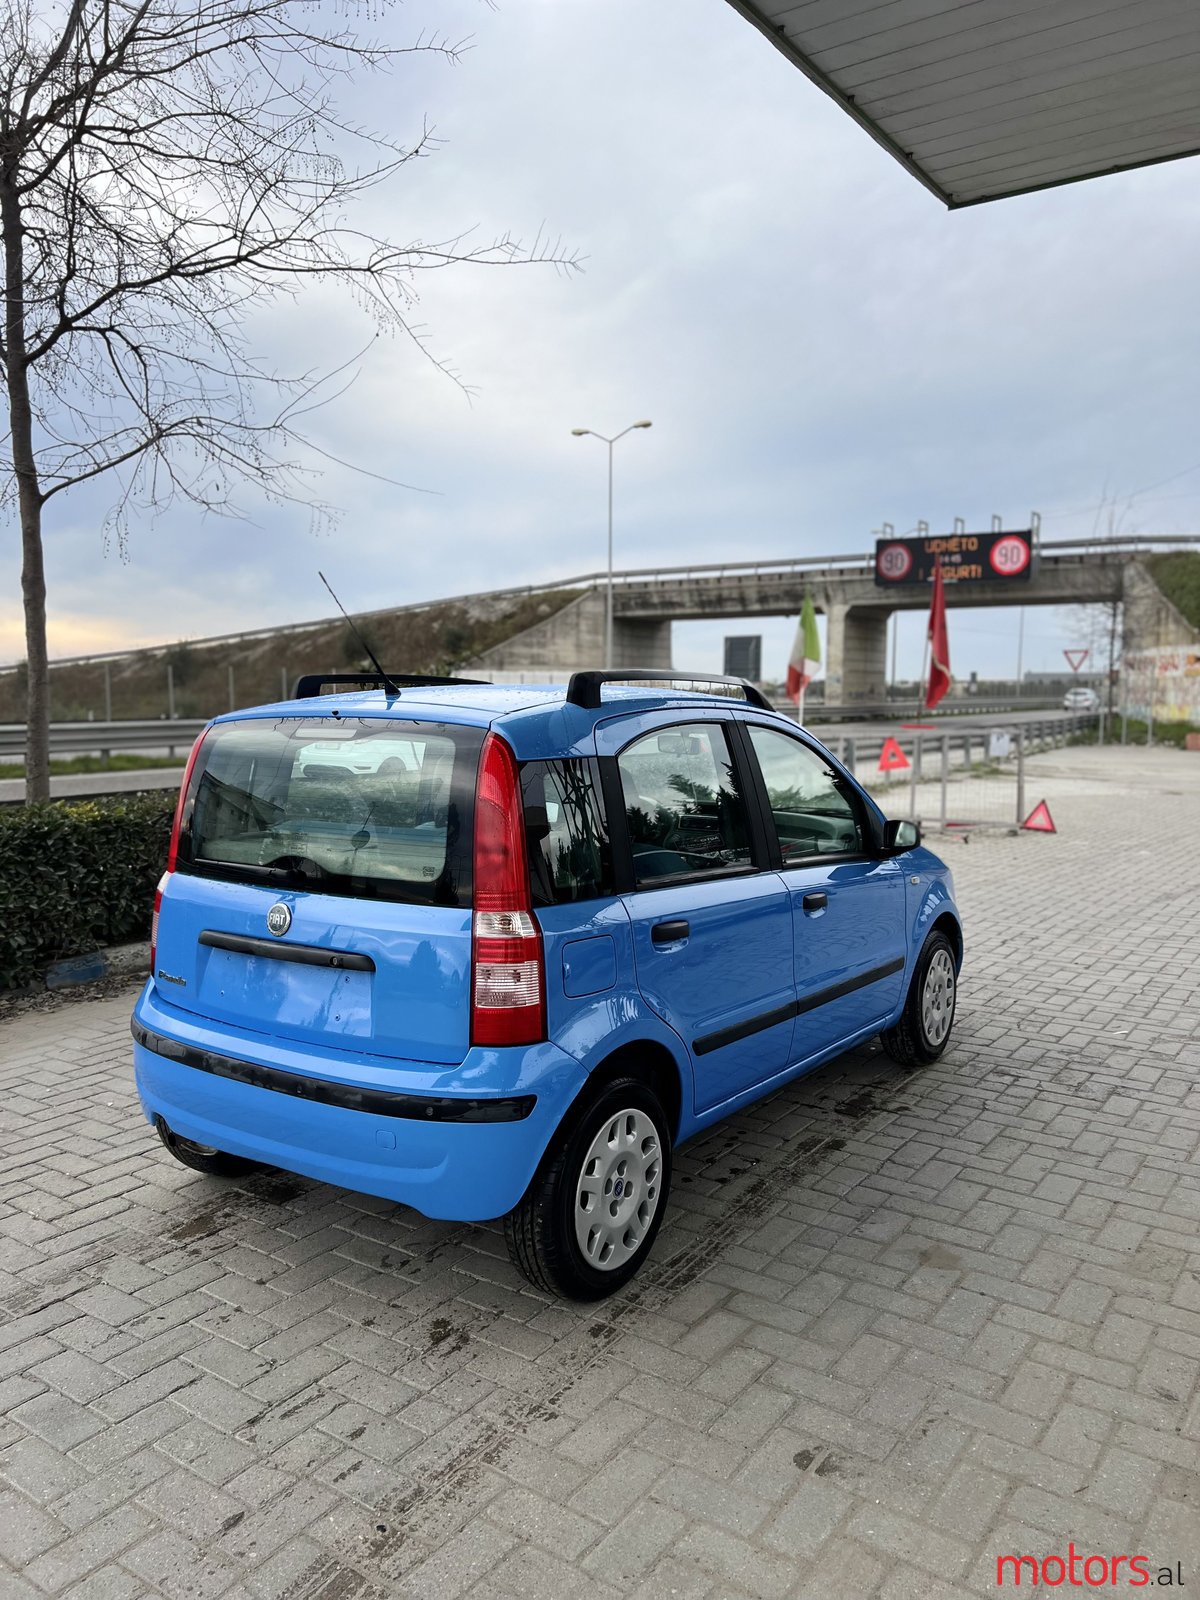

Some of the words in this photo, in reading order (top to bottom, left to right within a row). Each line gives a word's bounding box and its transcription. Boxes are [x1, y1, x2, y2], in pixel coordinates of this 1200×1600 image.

[884, 550, 905, 572] 90
[998, 545, 1020, 566] 90
[269, 912, 286, 925] FIAT
